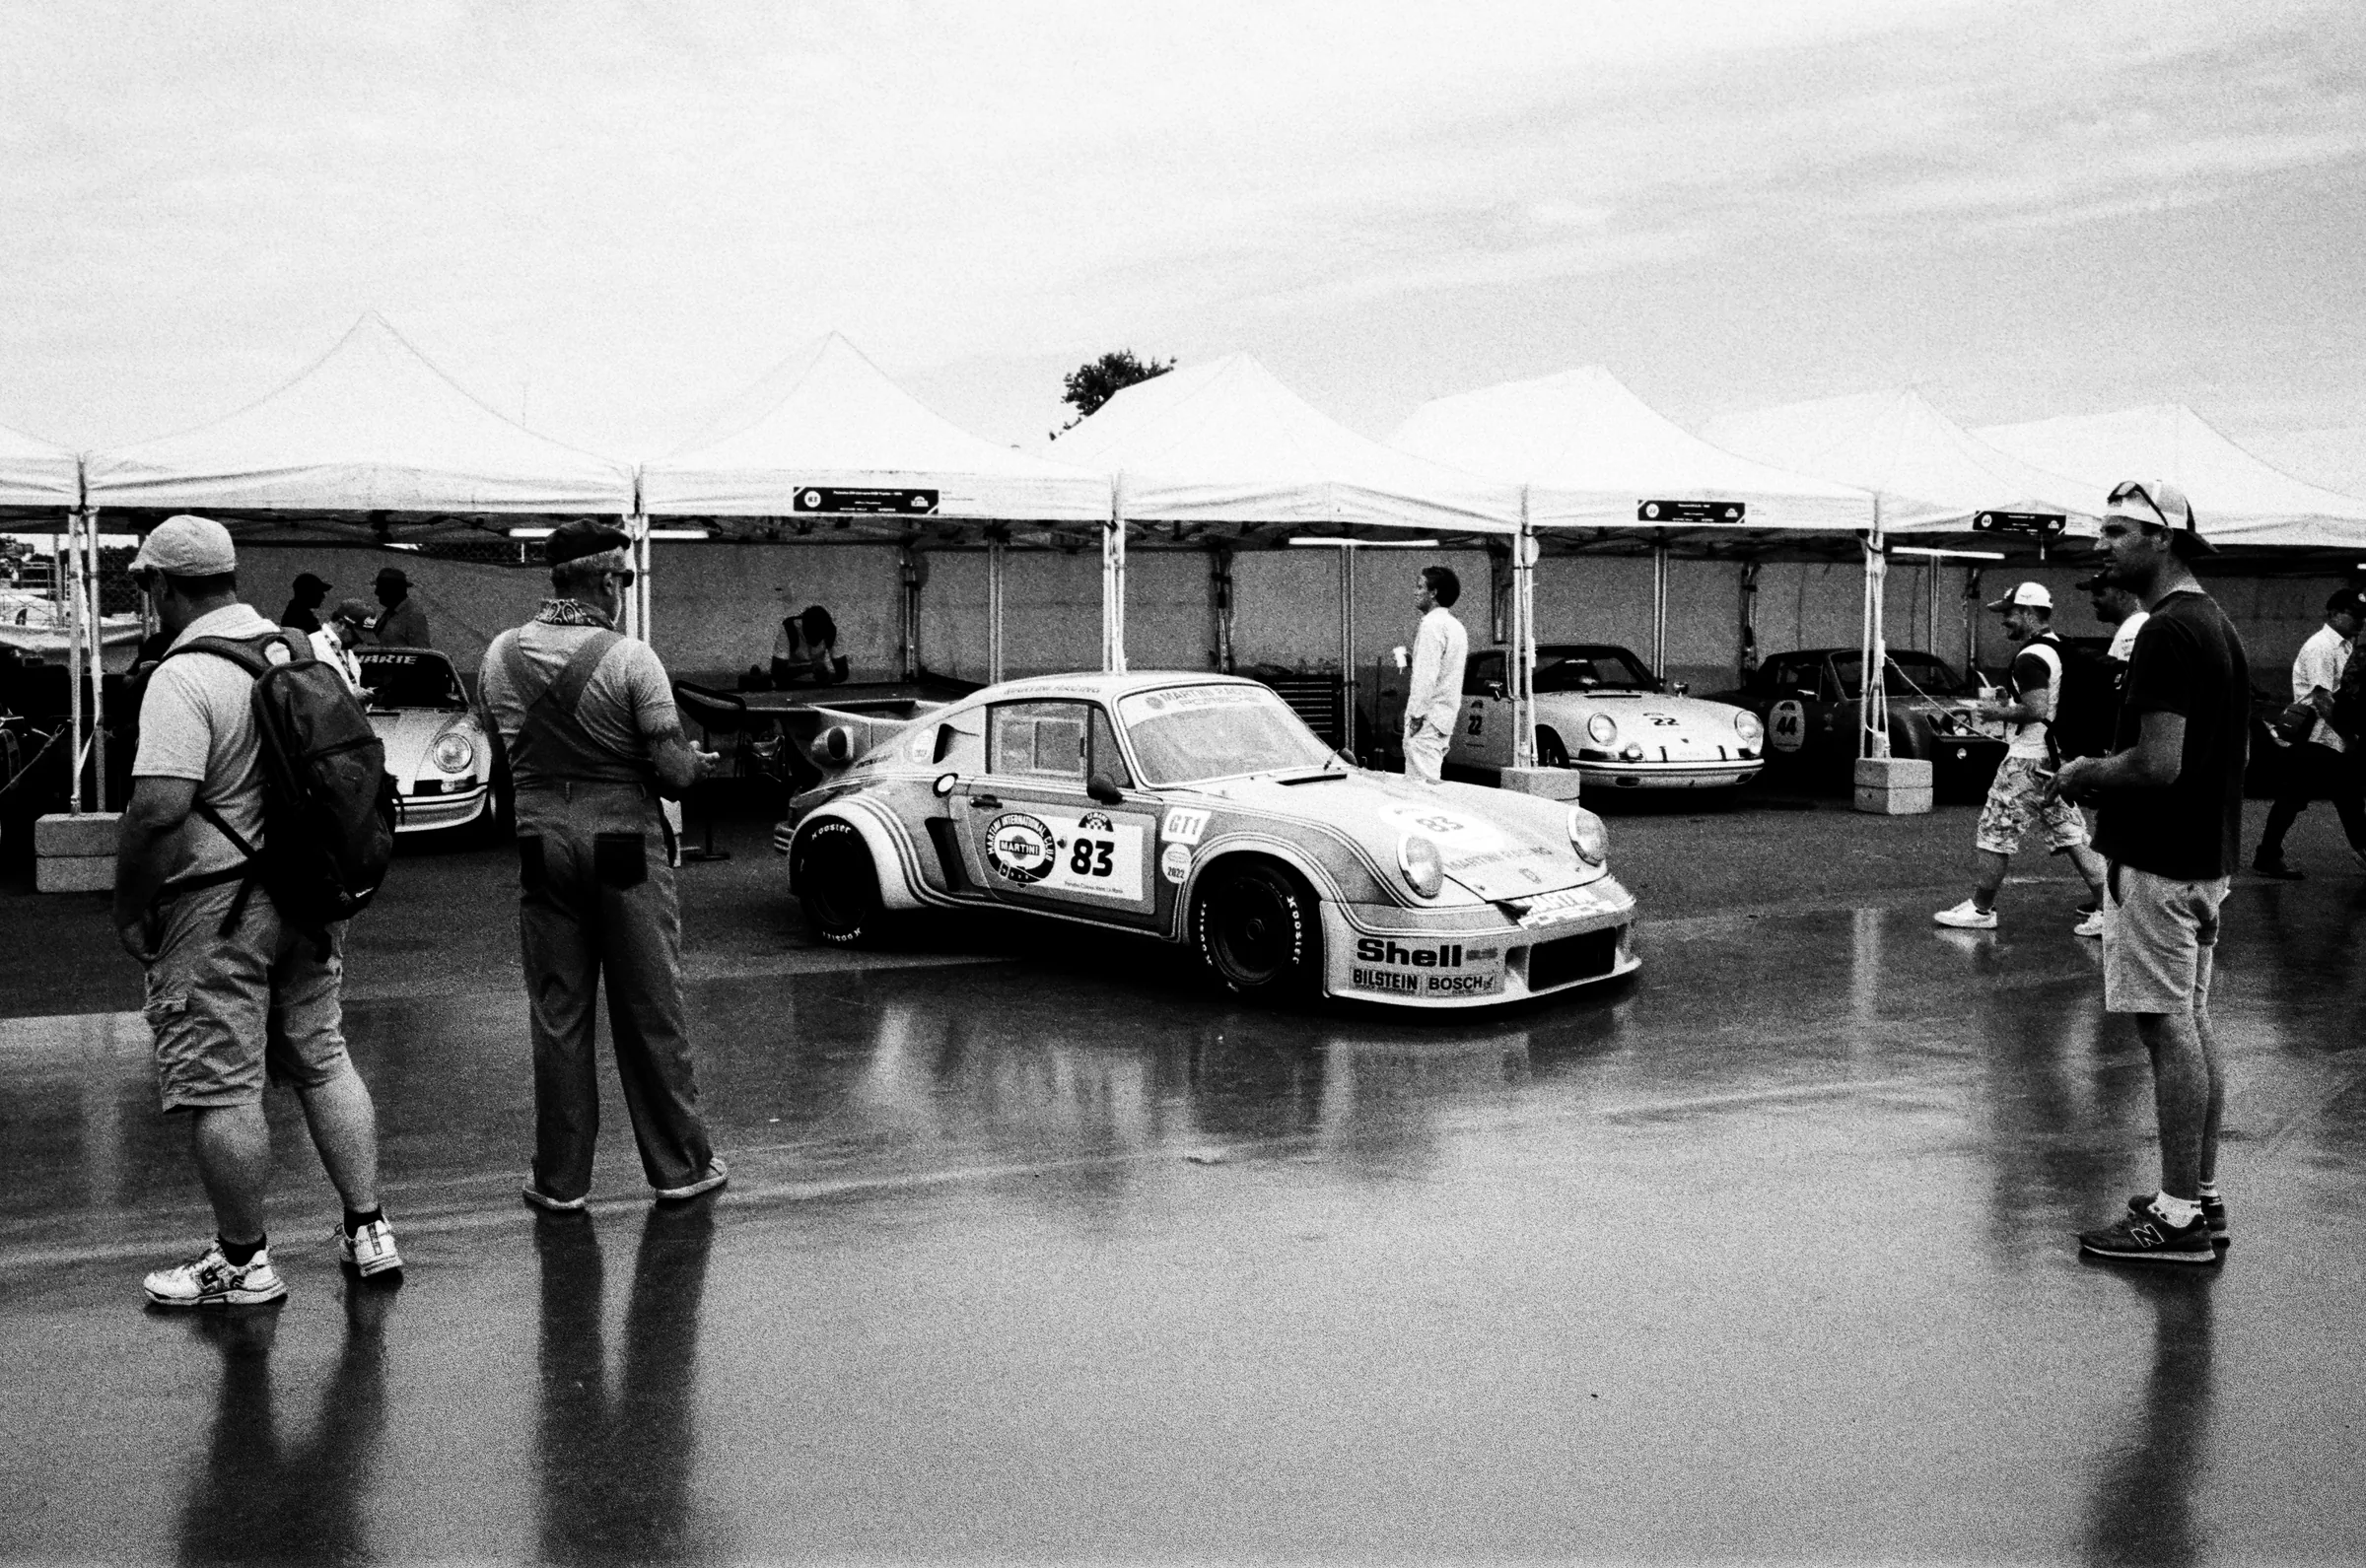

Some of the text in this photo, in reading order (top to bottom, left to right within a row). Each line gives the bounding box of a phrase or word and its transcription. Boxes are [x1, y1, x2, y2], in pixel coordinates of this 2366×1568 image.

[1159, 689, 1215, 702] MARTINI
[1468, 715, 1483, 735] 22
[1649, 717, 1680, 726] 22
[1775, 716, 1798, 736] 44
[1168, 814, 1202, 836] GT1
[1416, 816, 1465, 833] 83
[986, 813, 1055, 862] MARTINI INTERNATIONAL CLUB
[1000, 841, 1039, 855] MARTINI
[1070, 838, 1115, 877] 83
[1357, 938, 1462, 968] Shell
[1354, 969, 1418, 990] BILSTEIN
[1429, 976, 1483, 990] BOSCH
